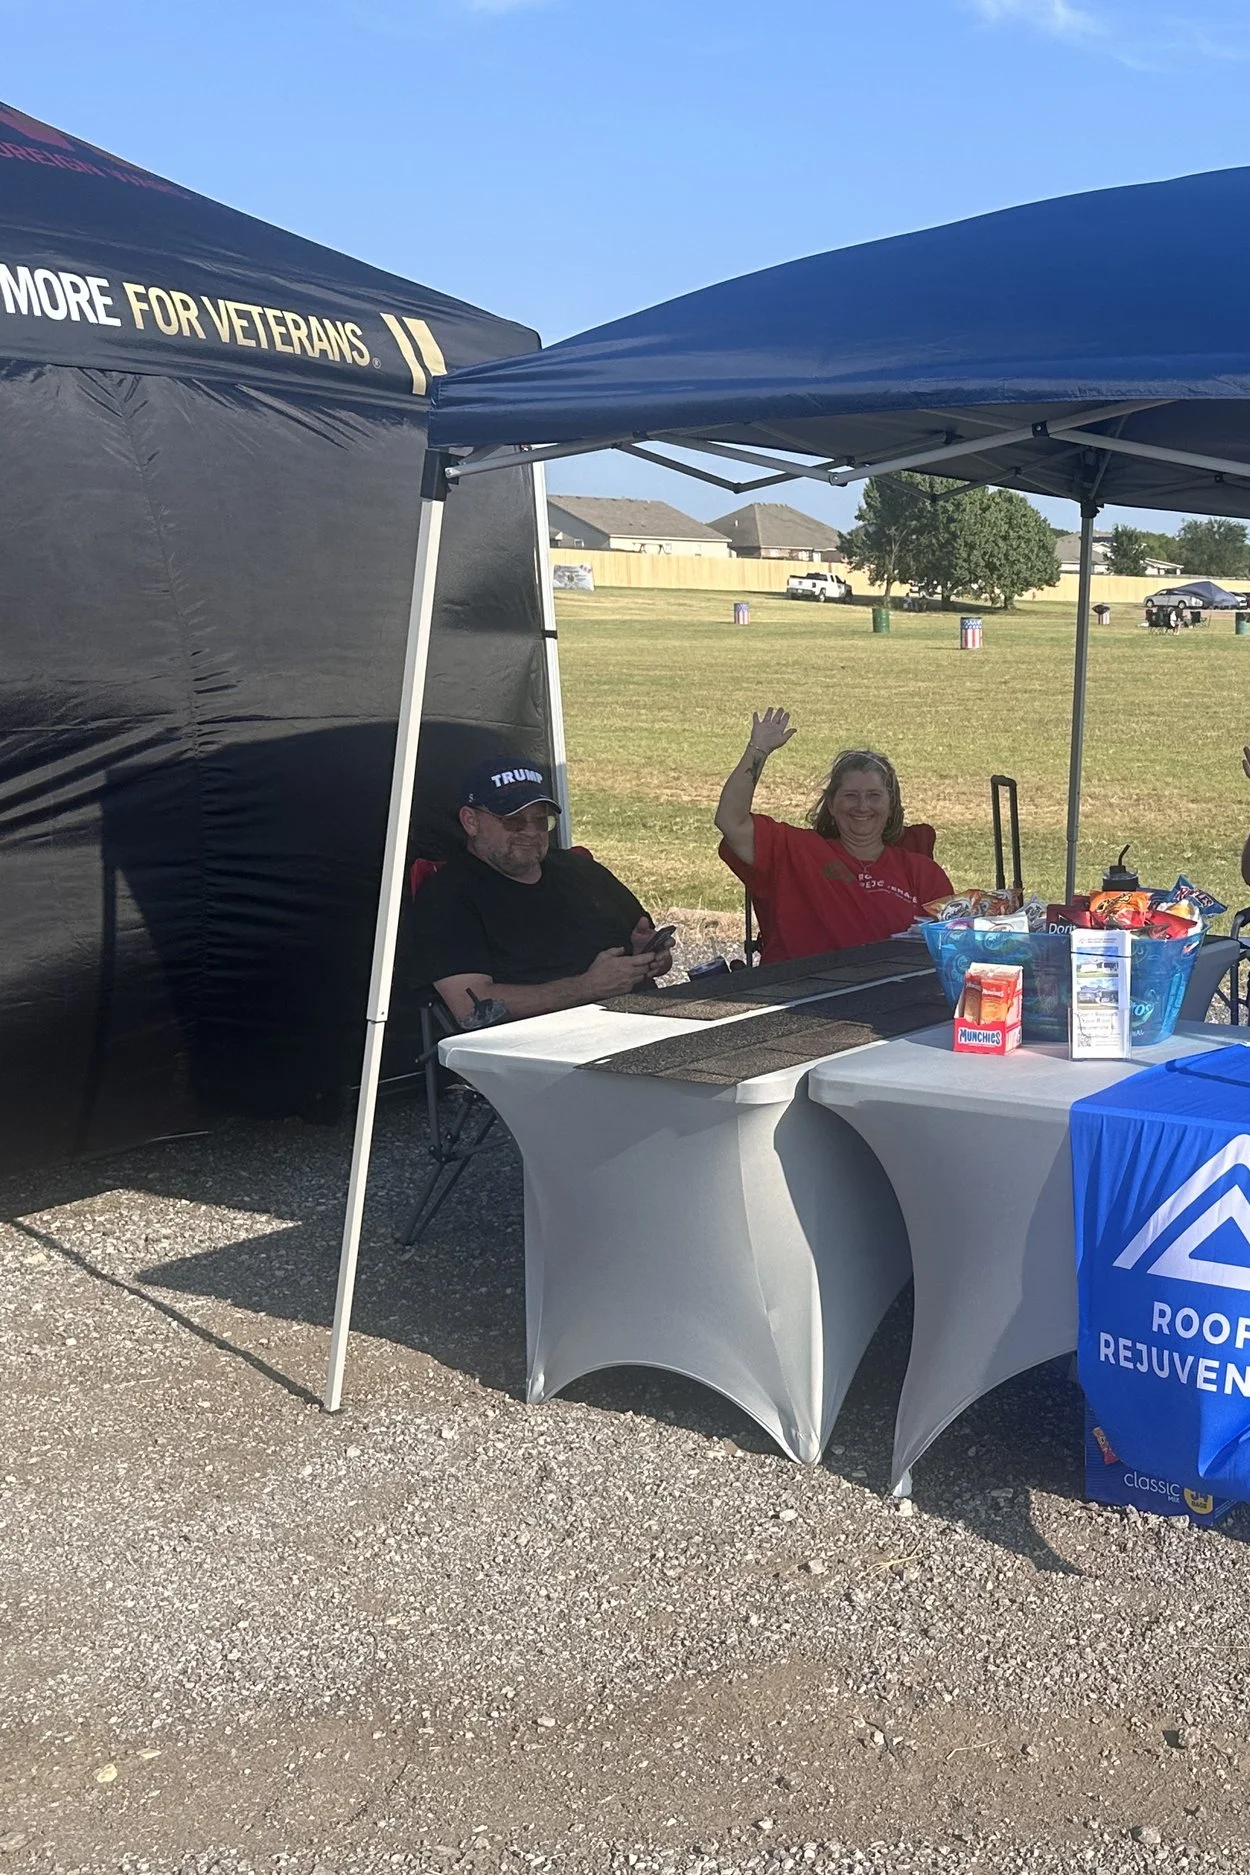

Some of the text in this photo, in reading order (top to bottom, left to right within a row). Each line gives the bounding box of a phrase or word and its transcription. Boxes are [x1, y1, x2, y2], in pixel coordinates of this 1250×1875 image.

[0, 264, 122, 328] MORE
[122, 281, 207, 340] FOR
[491, 768, 543, 788] TRUMP
[1123, 1470, 1181, 1497] classic
[1167, 1494, 1180, 1504] MIX
